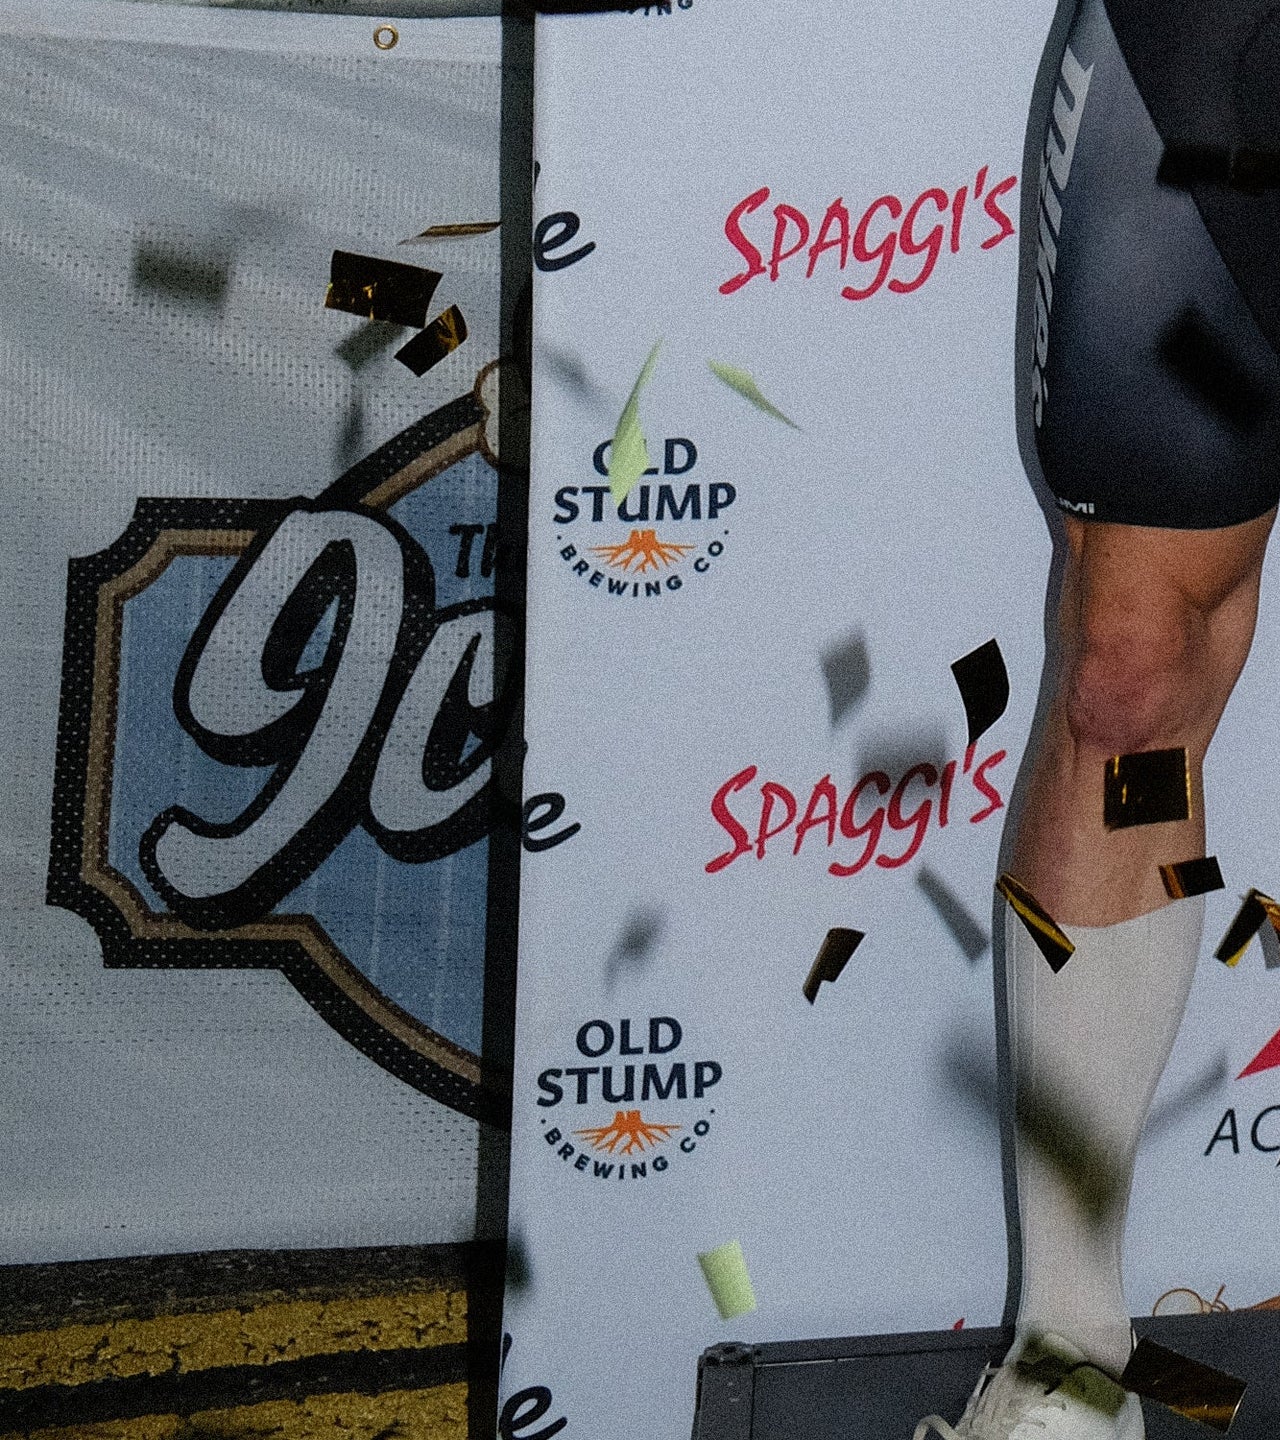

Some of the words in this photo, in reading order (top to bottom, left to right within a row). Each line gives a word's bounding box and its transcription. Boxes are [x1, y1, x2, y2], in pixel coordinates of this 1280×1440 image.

[718, 165, 1018, 301] SPAGGI'S
[552, 481, 737, 525] STUMP
[558, 543, 684, 598] BREWING
[704, 740, 1007, 877] SPAGGI'S
[574, 1016, 684, 1059] OLD
[536, 1060, 724, 1108] STUMP
[541, 1126, 670, 1181] BREWING
